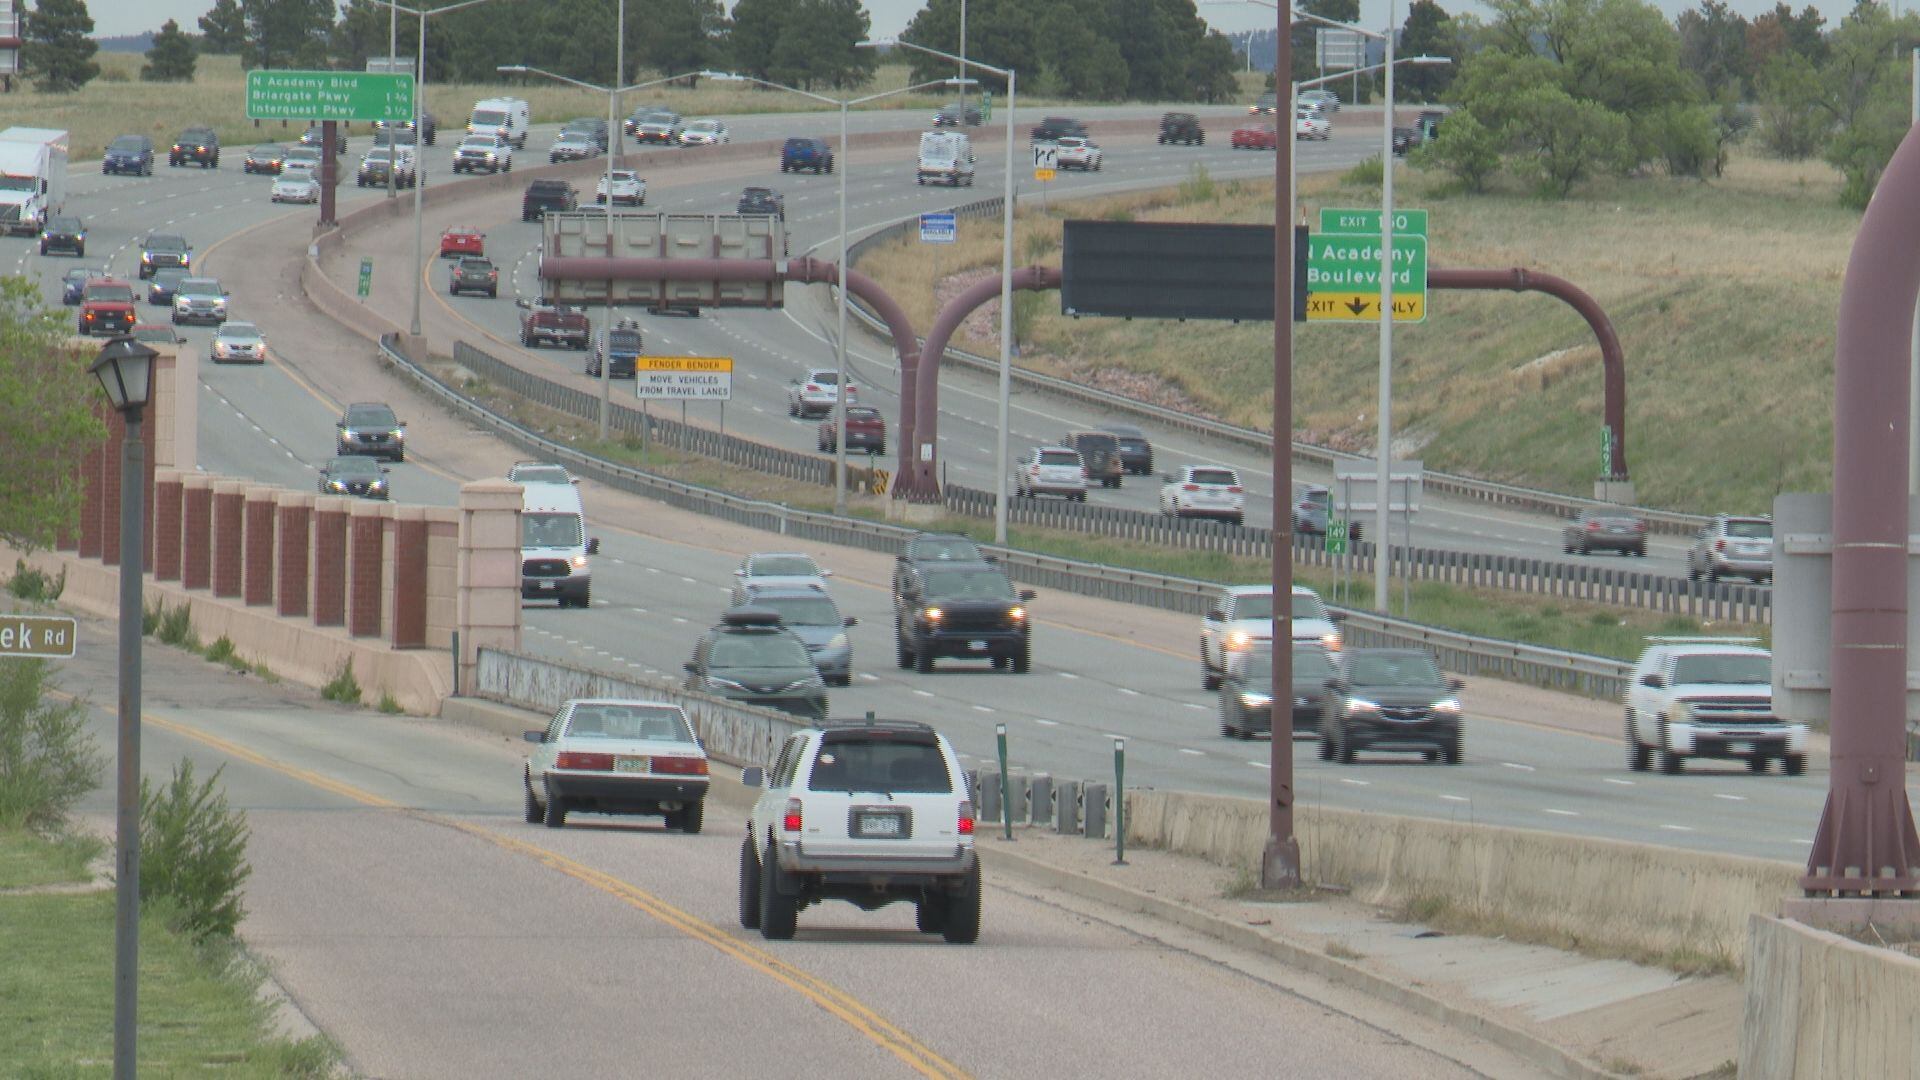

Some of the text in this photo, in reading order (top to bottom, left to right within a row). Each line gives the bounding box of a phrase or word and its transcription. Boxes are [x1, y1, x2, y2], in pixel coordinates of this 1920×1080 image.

[252, 77, 261, 86] N
[268, 77, 324, 89] Academy
[330, 78, 358, 88] Blvd
[252, 91, 312, 102] Briargate
[317, 91, 350, 103] Pkwy
[252, 104, 317, 116] Interquest
[323, 104, 356, 116] Pkwy
[384, 107, 392, 116] 3
[1340, 215, 1408, 230] EXIT 10
[648, 359, 720, 370] FENDER BENDER
[649, 375, 719, 385] MOVE VEHICLES
[640, 386, 728, 396] FROM TRAVEL LANES
[1328, 527, 1345, 538] 149
[0, 622, 65, 649] ek Rd
